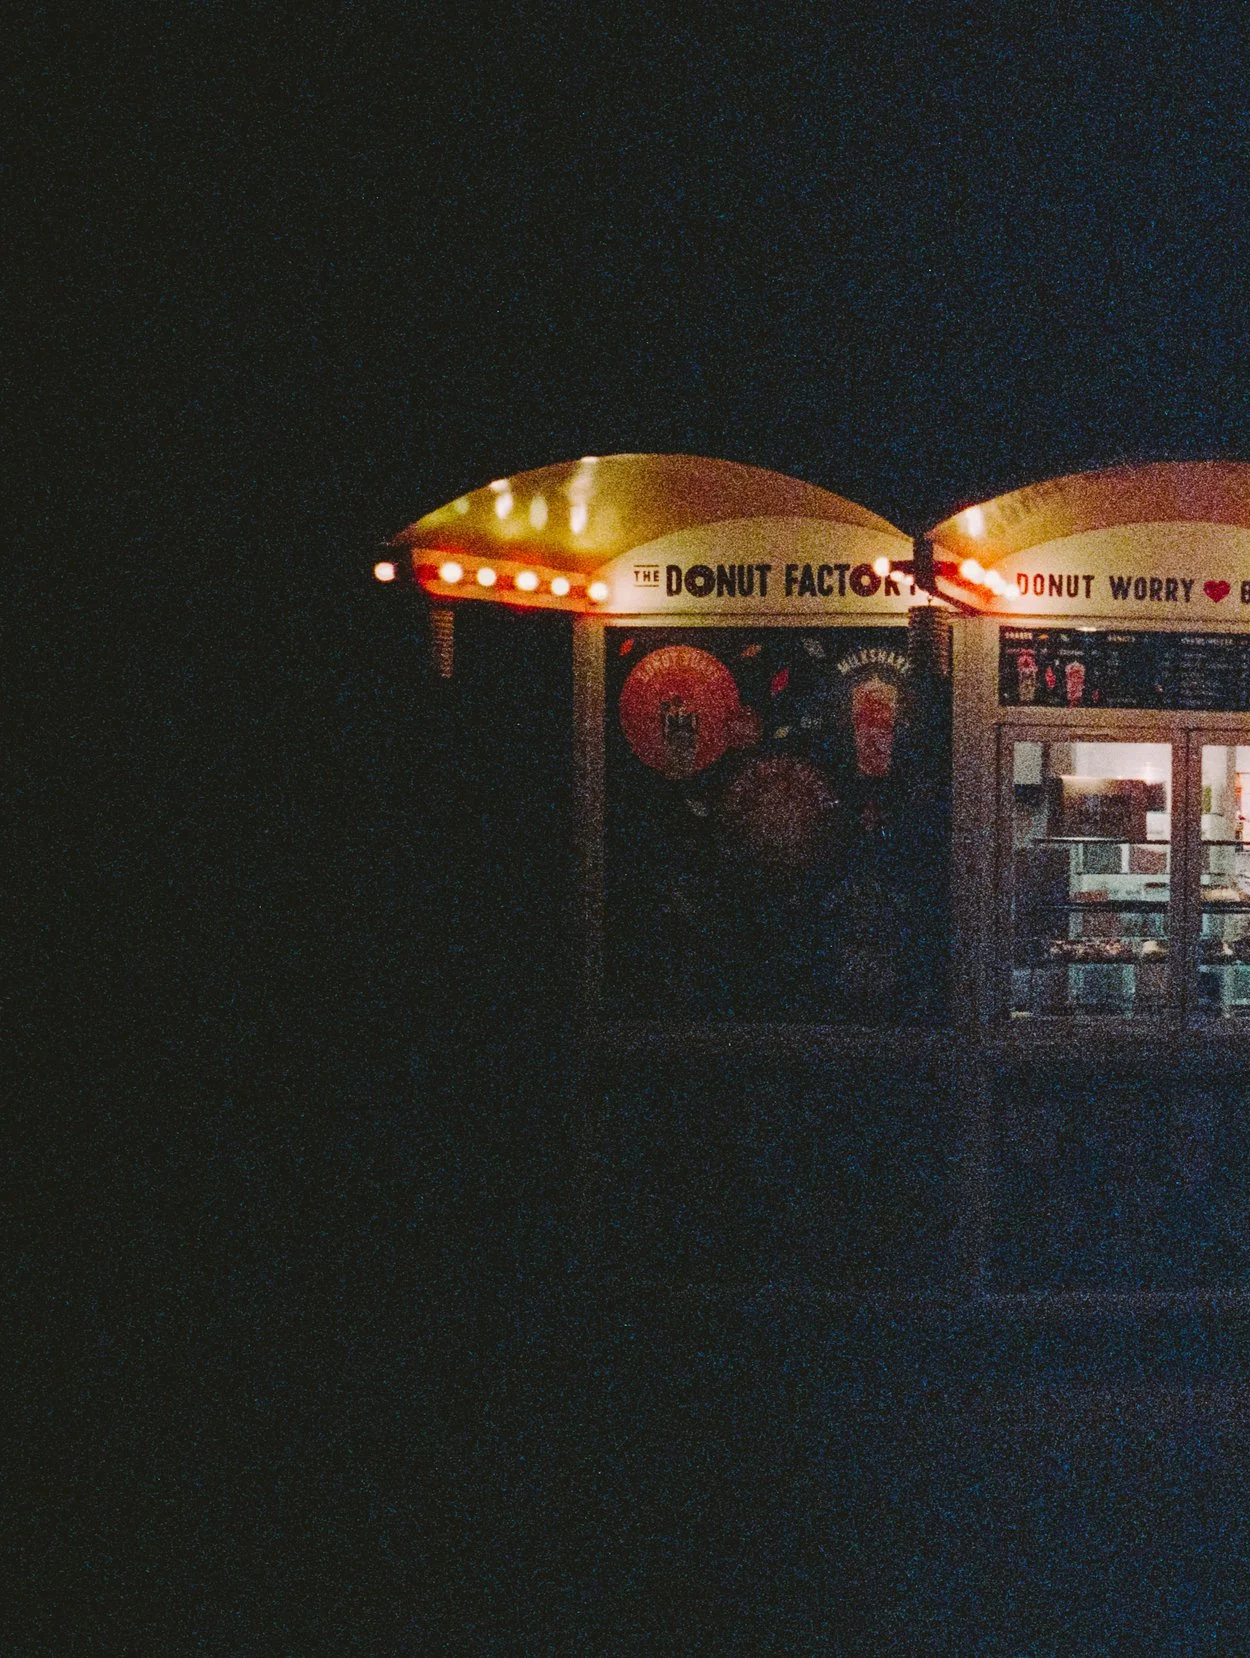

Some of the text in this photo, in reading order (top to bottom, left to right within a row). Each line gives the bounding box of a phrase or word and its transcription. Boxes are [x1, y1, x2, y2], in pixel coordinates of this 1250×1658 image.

[634, 563, 916, 597] THE DONUT FACTOR
[1017, 573, 1094, 598] DONUT
[1109, 575, 1195, 603] WORRY
